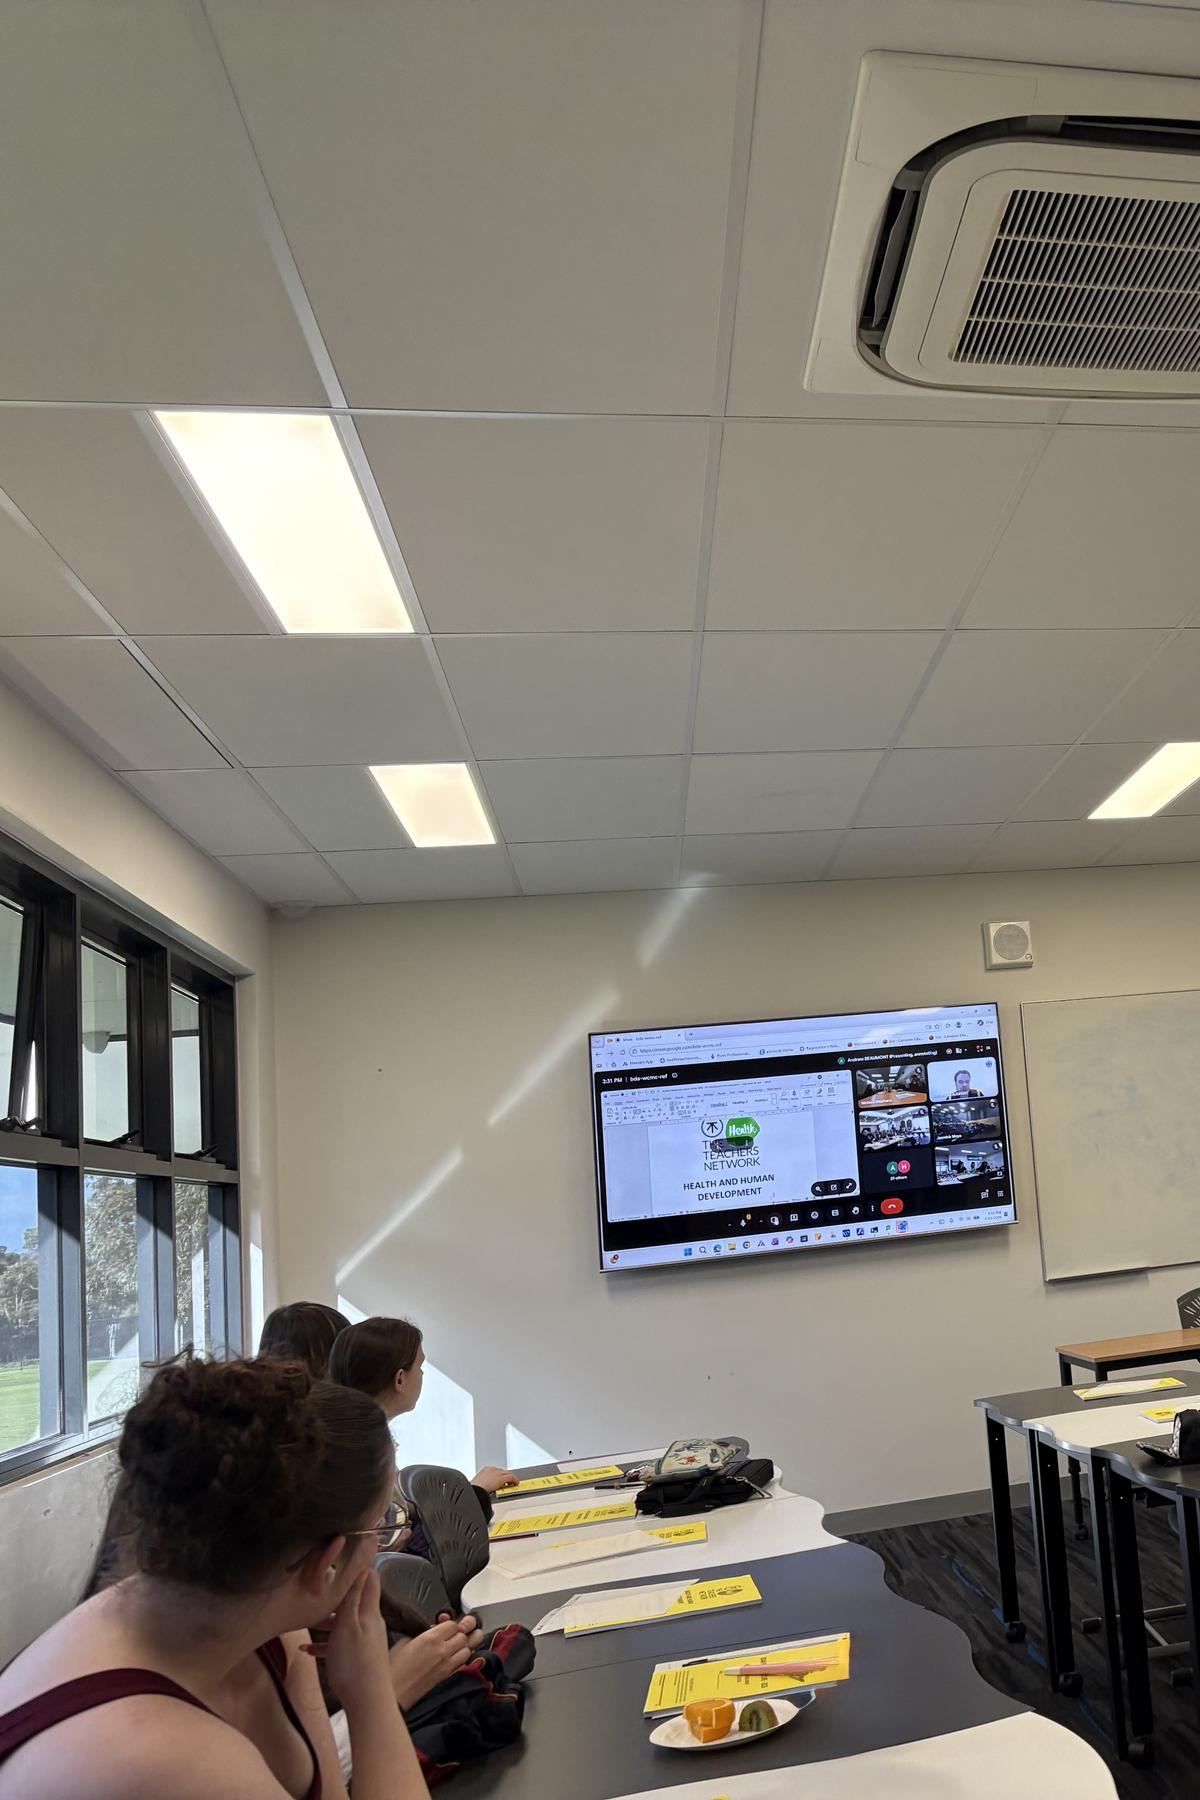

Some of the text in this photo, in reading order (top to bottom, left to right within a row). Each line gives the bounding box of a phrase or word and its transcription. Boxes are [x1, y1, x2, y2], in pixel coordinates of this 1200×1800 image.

[728, 1124, 758, 1136] Health
[703, 1146, 759, 1160] TEACHERS
[704, 1157, 760, 1171] NETWORK
[683, 1174, 775, 1190] HEALTH AND HUMAN
[698, 1187, 762, 1201] DEVELOPMENT
